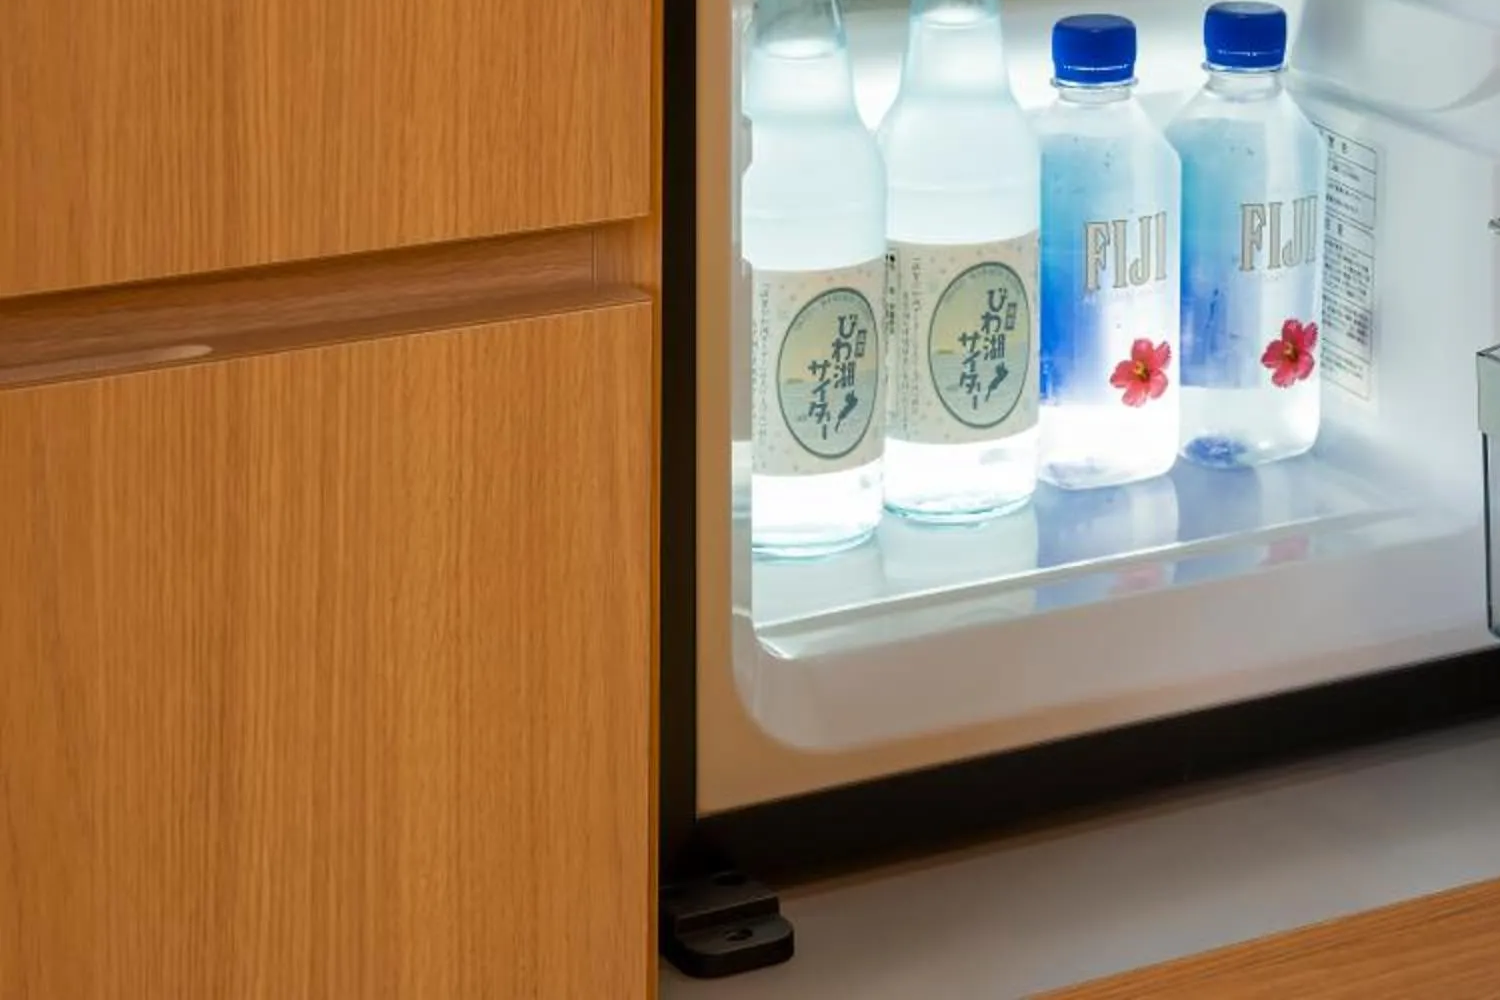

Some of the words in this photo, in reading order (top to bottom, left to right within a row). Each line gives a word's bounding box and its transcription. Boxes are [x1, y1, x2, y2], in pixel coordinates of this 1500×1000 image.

[1083, 211, 1168, 294] FIJI
[1239, 195, 1318, 272] FIJI
[807, 359, 832, 441] サイダー
[957, 330, 982, 411] サイダー
